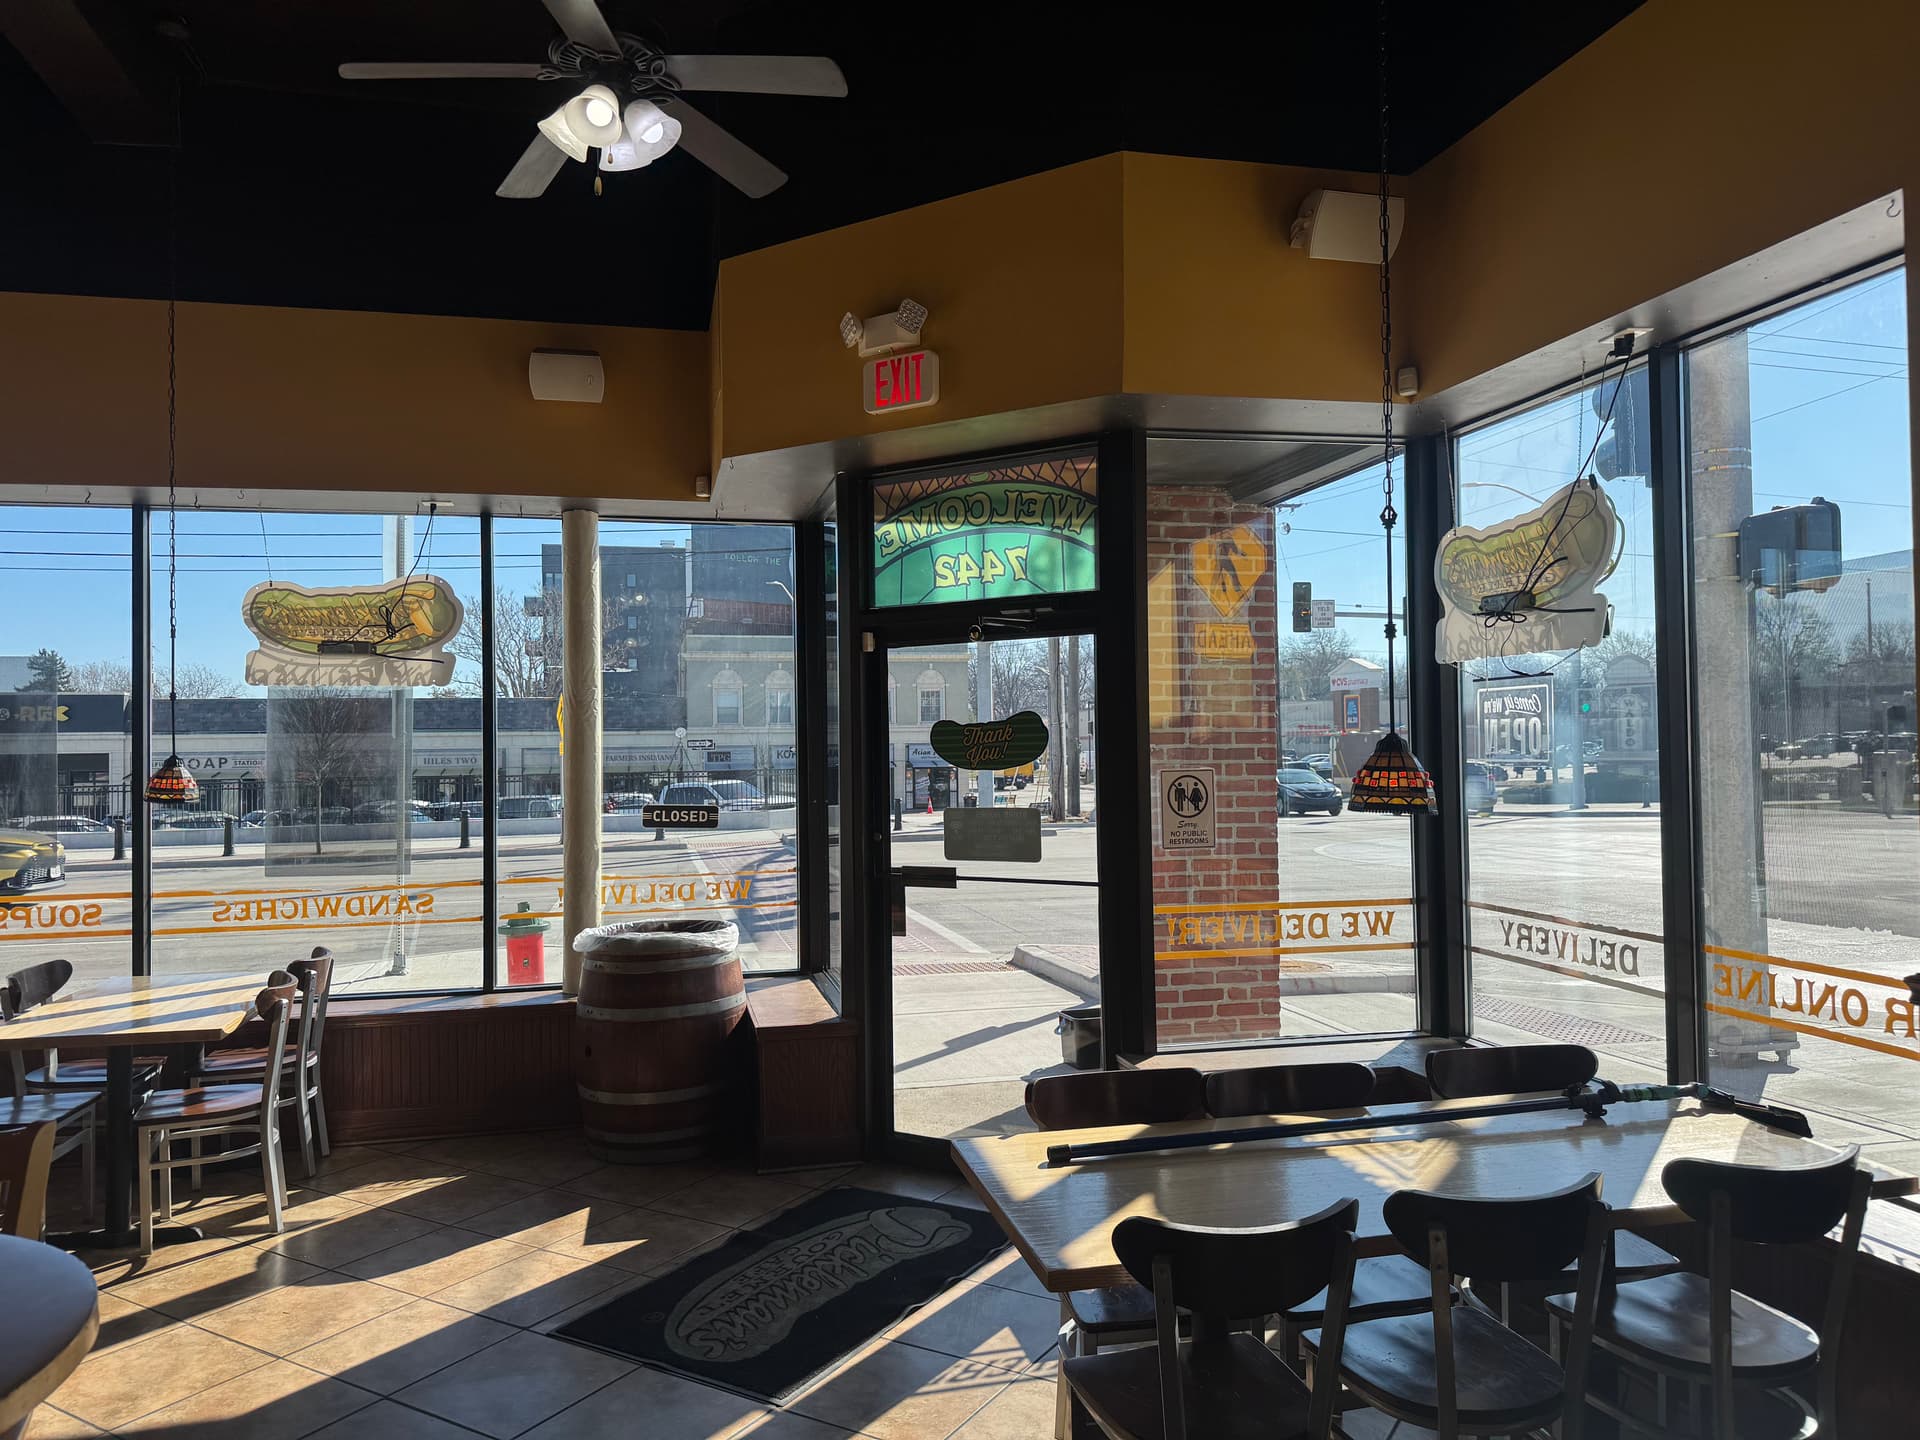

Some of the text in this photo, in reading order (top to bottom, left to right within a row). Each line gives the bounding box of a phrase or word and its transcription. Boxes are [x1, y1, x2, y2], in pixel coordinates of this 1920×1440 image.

[875, 353, 925, 408] EXIT
[765, 556, 782, 566] THE
[1336, 678, 1348, 686] CVS
[1624, 699, 1636, 747] WALDO
[962, 724, 1014, 746] Thank
[423, 756, 477, 765] HILES TWO
[605, 754, 638, 762] FARMERS
[966, 742, 1009, 768] You!
[183, 758, 228, 769] OAP
[653, 810, 708, 823] CLOSED
[1169, 837, 1209, 846] RESTROOMS
